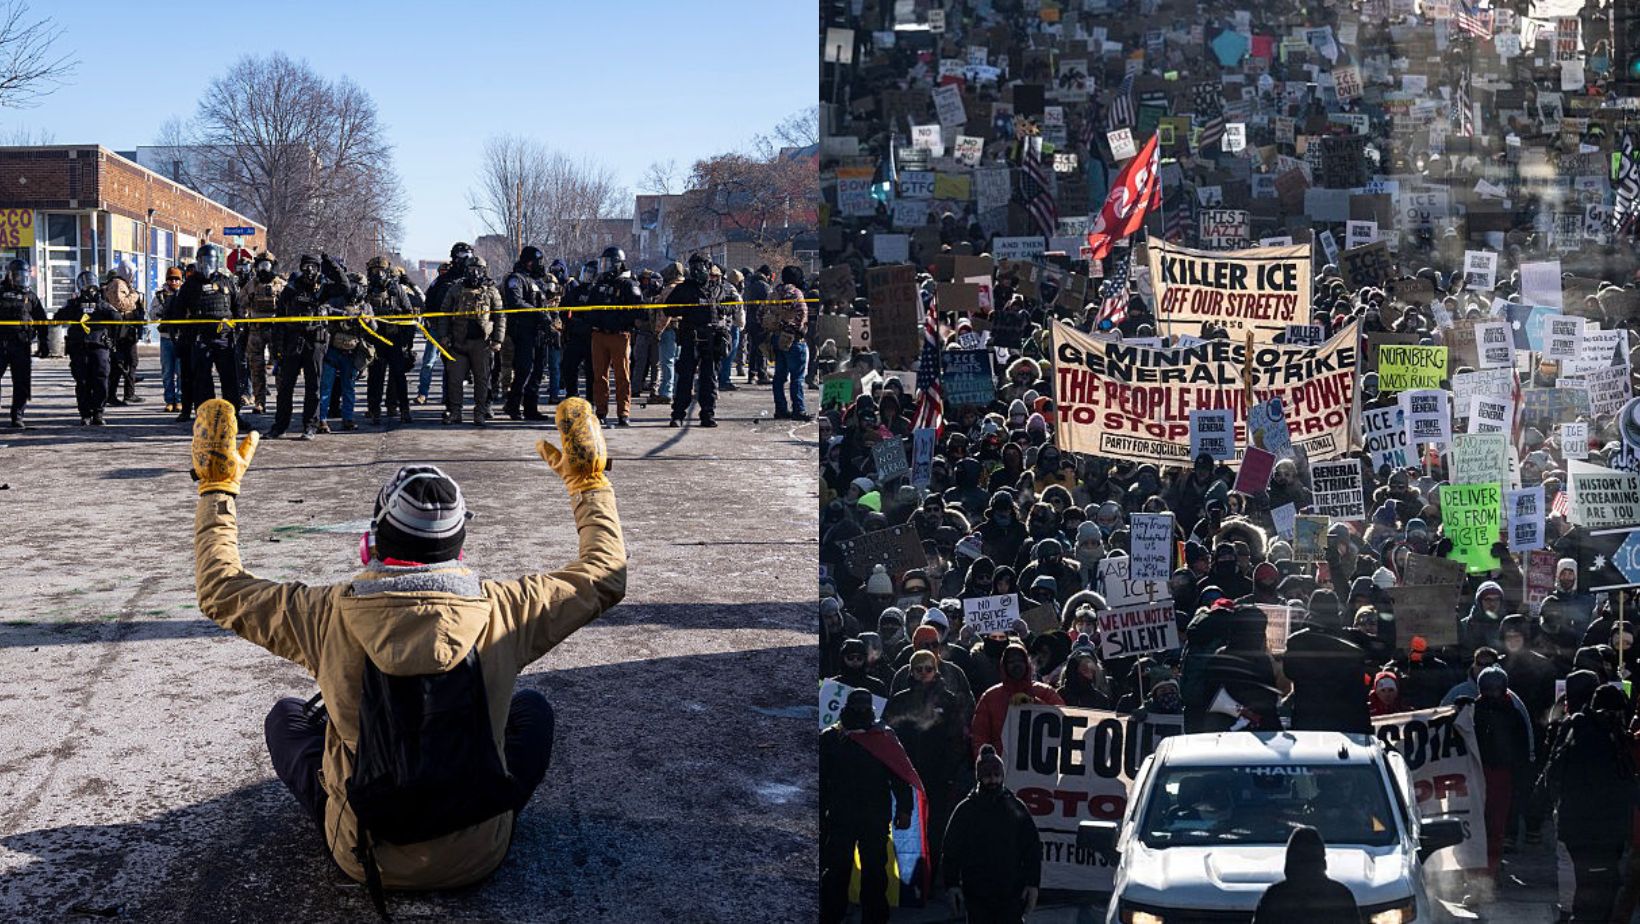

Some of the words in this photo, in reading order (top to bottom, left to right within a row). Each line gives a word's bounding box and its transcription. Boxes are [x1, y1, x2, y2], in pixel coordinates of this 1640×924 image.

[1559, 19, 1578, 30] NO
[1558, 40, 1577, 50] NO
[1336, 72, 1356, 85] ICE
[919, 128, 931, 136] NO
[1054, 154, 1077, 162] ICE
[1410, 194, 1436, 206] ICE
[1202, 211, 1235, 225] THIS
[1203, 225, 1242, 237] NAZI
[1160, 255, 1248, 290] KILLER
[1256, 263, 1298, 291] ICE
[1160, 288, 1190, 312] OFF
[1190, 288, 1223, 313] OUR
[1226, 290, 1298, 320] STREETS!
[1290, 326, 1320, 338] KILLER
[1552, 327, 1576, 336] GENERAL
[954, 354, 974, 363] ICE
[1105, 340, 1318, 366] MINNESOTA
[1058, 343, 1235, 384] GENERAL
[1242, 348, 1356, 386] STRIKE
[1058, 368, 1101, 406] THE
[1104, 382, 1191, 422] PEOPLE
[1412, 402, 1439, 414] GENERAL
[1478, 408, 1505, 421] GENERAL
[1058, 406, 1096, 424] TO
[1104, 412, 1189, 440] STOP
[1198, 423, 1226, 432] GENERAL
[1366, 412, 1393, 432] ICE
[1415, 419, 1439, 430] STRIKE!
[1565, 425, 1583, 436] ICE
[1104, 436, 1132, 450] PARTY
[1133, 440, 1150, 452] FOR
[1370, 432, 1399, 451] OUT
[880, 450, 899, 464] NOT
[1382, 451, 1407, 466] MN
[1313, 464, 1360, 478] GENERAL
[1314, 478, 1361, 492] STRIKE:
[1580, 478, 1622, 490] HISTORY
[1627, 477, 1637, 490] IS
[1315, 494, 1330, 504] THE
[1331, 493, 1350, 504] PATH
[1352, 492, 1362, 502] TO
[1444, 488, 1498, 506] DELIVER
[1580, 491, 1639, 504] SCREAMING
[1319, 504, 1363, 517] JUSTICE
[1586, 506, 1606, 518] ARE
[1612, 506, 1634, 517] YOU
[1445, 510, 1459, 526] US
[1465, 509, 1497, 526] FROM
[1133, 517, 1148, 534] Hey
[1452, 526, 1489, 546] ICE
[1123, 580, 1159, 598] ICE
[978, 600, 990, 610] NO
[968, 609, 1008, 622] JUSTICE
[1098, 612, 1118, 632] WE
[1119, 610, 1140, 628] WILL
[1142, 608, 1162, 624] NOT
[1163, 607, 1175, 621] BE
[984, 618, 1014, 630] PEACE
[1106, 624, 1169, 656] SILENT
[1016, 710, 1088, 776] ICE
[1234, 766, 1314, 776] -HAUL
[1016, 786, 1128, 820] STO
